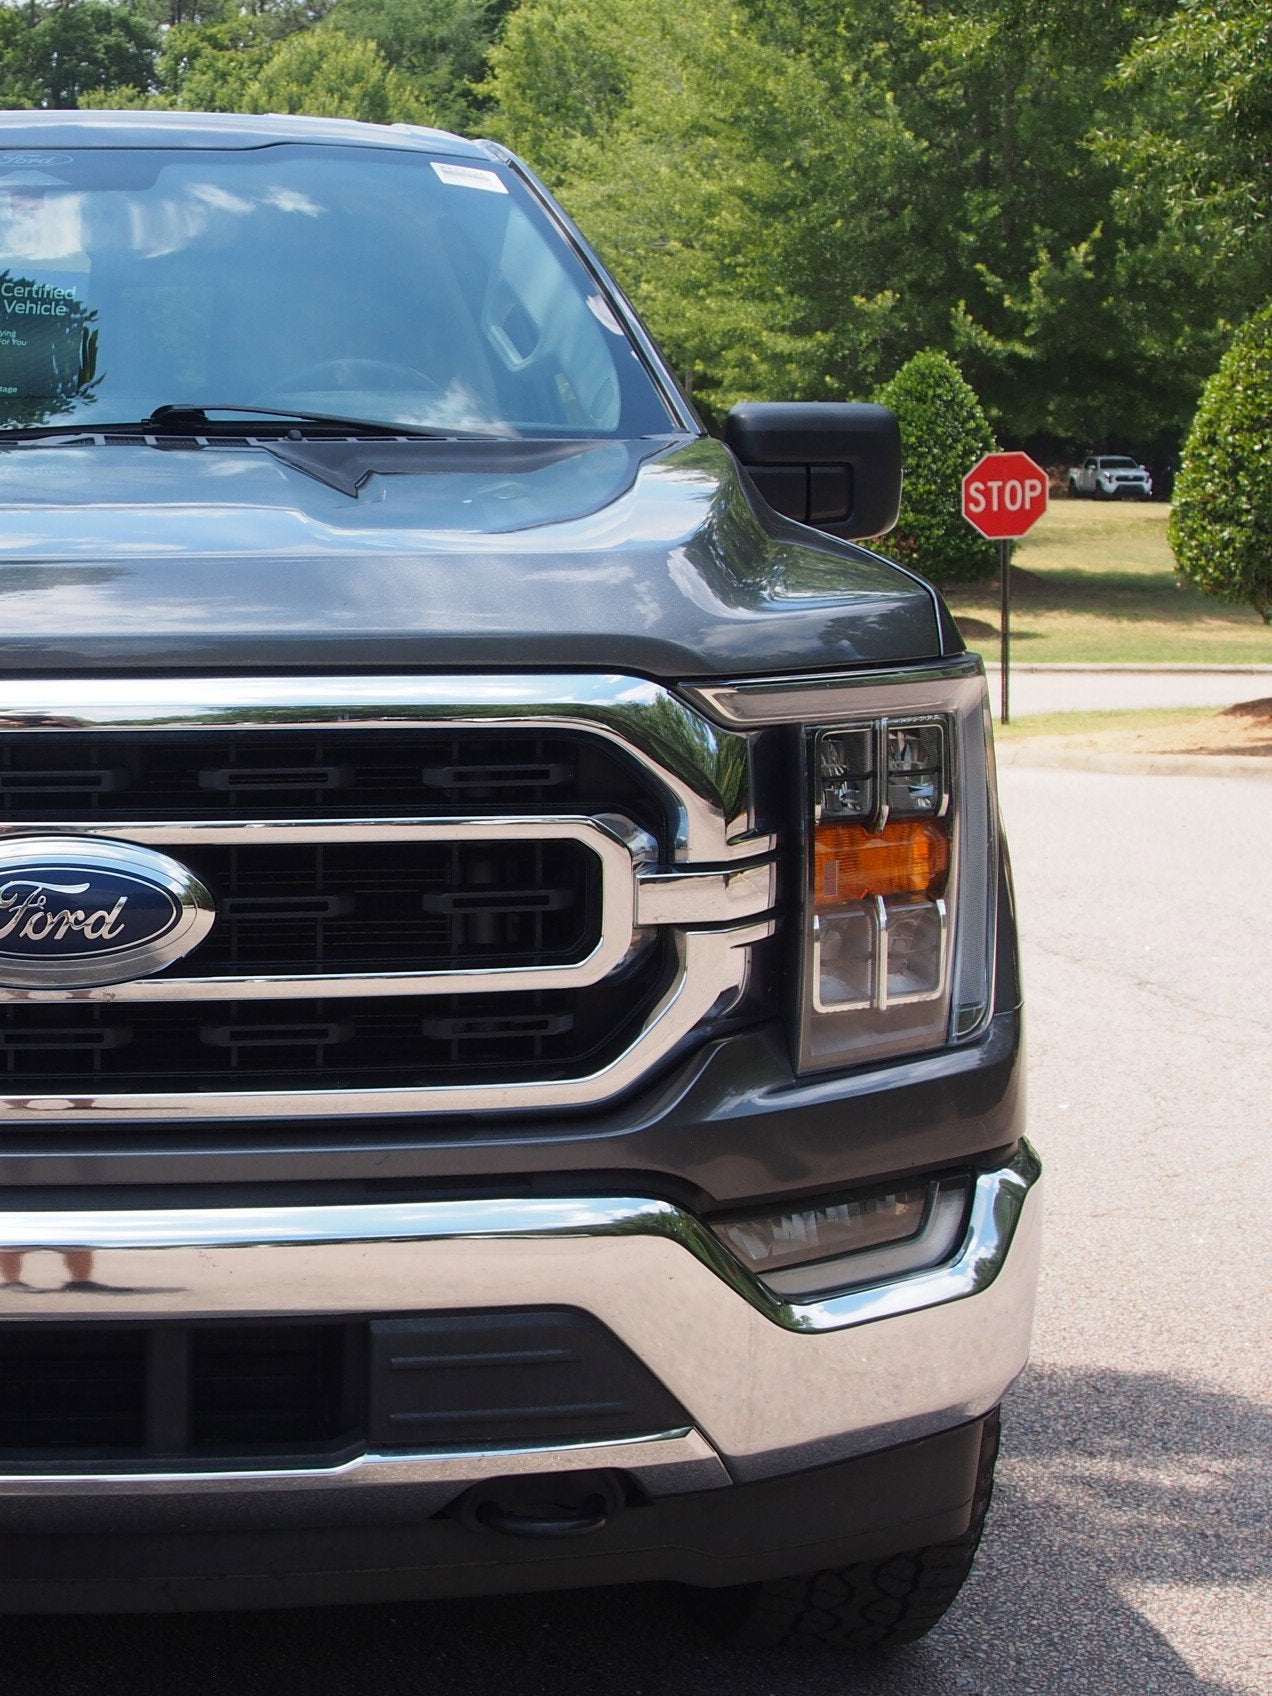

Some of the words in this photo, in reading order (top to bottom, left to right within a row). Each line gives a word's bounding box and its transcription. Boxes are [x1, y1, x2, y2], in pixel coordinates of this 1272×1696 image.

[0, 282, 77, 300] Certified
[3, 299, 68, 316] Vehicle
[12, 338, 27, 346] You
[969, 479, 1043, 513] STOP
